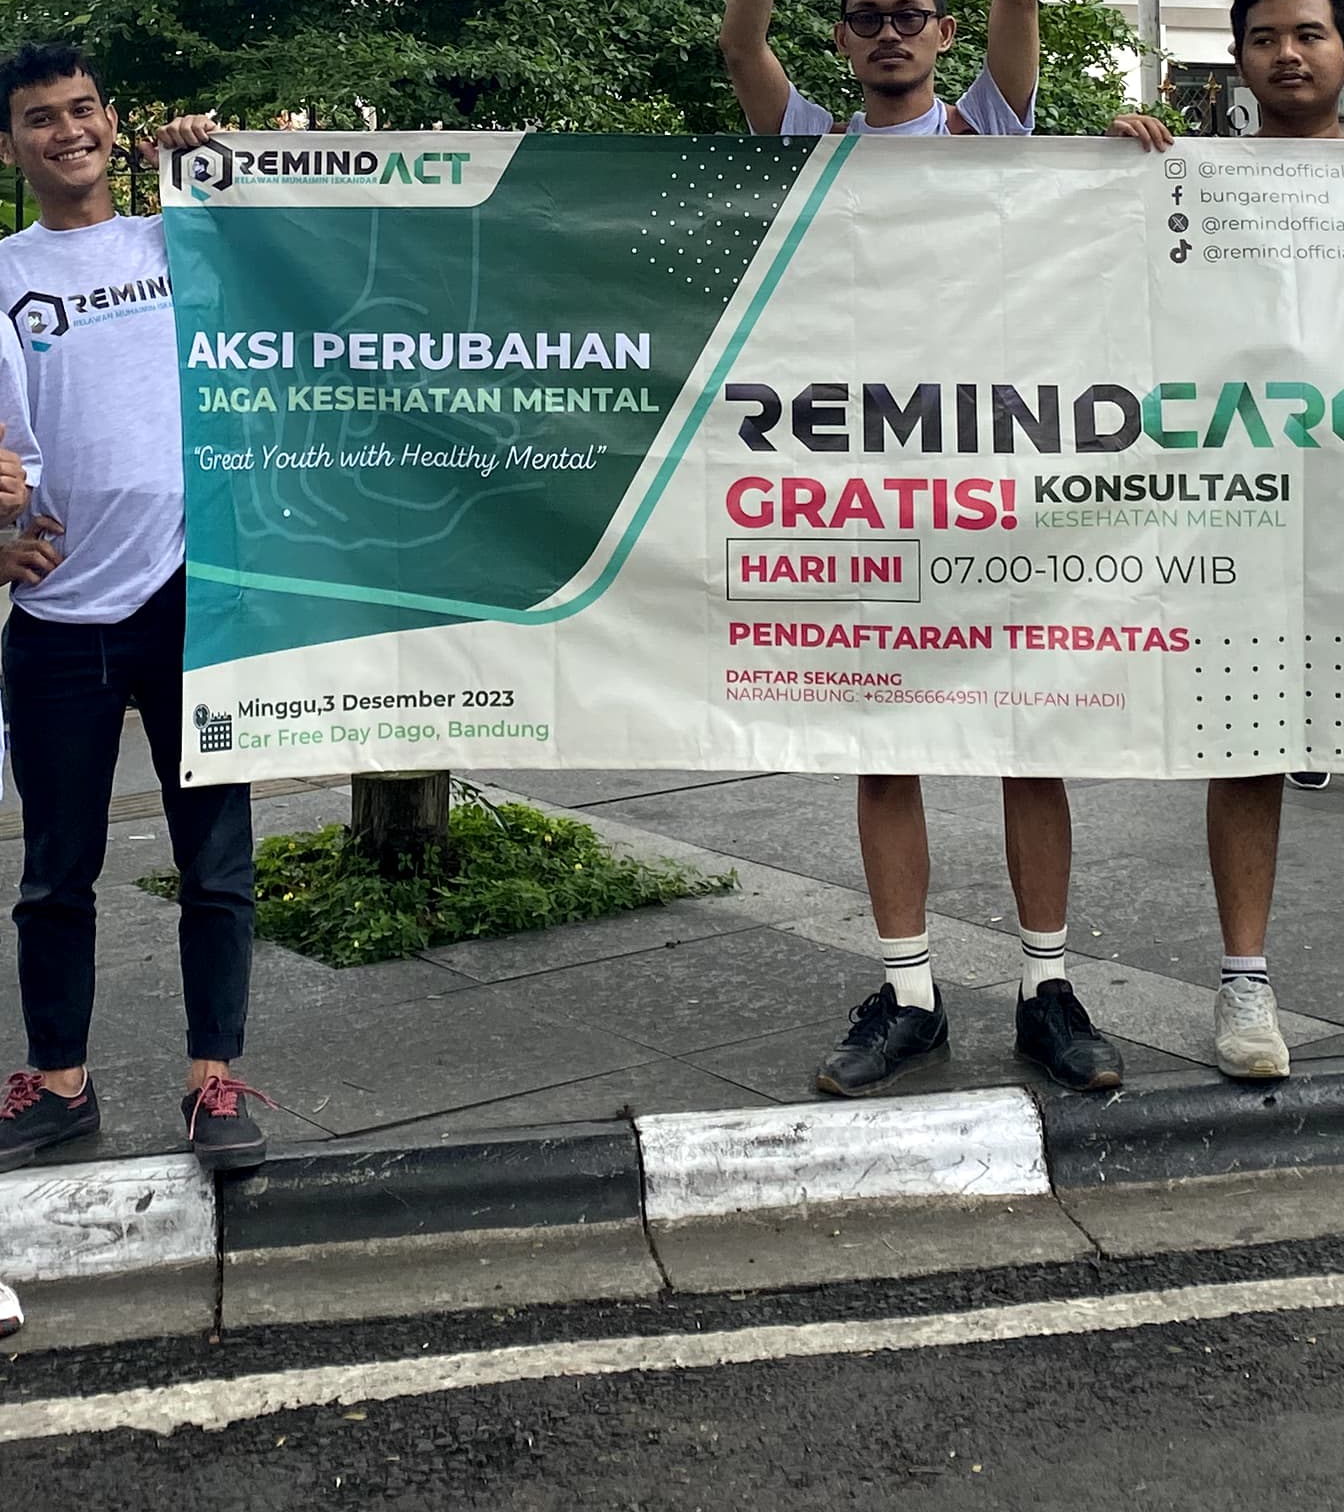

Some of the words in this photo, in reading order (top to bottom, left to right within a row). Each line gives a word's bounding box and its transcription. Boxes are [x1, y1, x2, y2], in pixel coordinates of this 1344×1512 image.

[234, 176, 280, 185] RELAWAN
[281, 176, 329, 185] MUHAIMIN
[330, 175, 378, 185] ISKANDAR
[1200, 188, 1330, 205] bungaremind
[68, 275, 173, 314] REMIN
[187, 331, 294, 370] AKSI
[313, 332, 650, 370] PERUBAHAN
[198, 387, 277, 412] JAGA
[287, 386, 501, 413] KESEHATAN
[513, 388, 660, 413] MENTAL
[260, 443, 334, 471] Youth
[339, 445, 394, 467] with
[400, 442, 500, 478] Healthy
[725, 476, 1017, 531] GRATIS!
[1033, 473, 1290, 504] KONSULTASI
[1034, 509, 1179, 529] KESEHATAN
[1186, 509, 1288, 529] MENTAL
[740, 554, 837, 584] HARI
[849, 555, 903, 584] INI
[929, 554, 1145, 586] 07.00-10.00
[1154, 554, 1238, 586] WIB
[728, 622, 993, 651] PENDAFTARAN
[1002, 624, 1191, 653] TERBATAS
[725, 669, 799, 685] DAFTAR
[803, 670, 904, 687] SEKARANG
[342, 690, 457, 712] Desember
[461, 690, 515, 708] 2023
[725, 686, 860, 704] NARAHUBUNG:
[863, 689, 989, 706] +628566649511
[993, 691, 1070, 708] (ZULFAN
[1074, 692, 1127, 710] HADI)
[238, 732, 272, 750] Car
[278, 727, 324, 747] Free
[330, 723, 372, 744] Day
[377, 722, 441, 743] Dago,
[448, 719, 550, 741] Bandung
